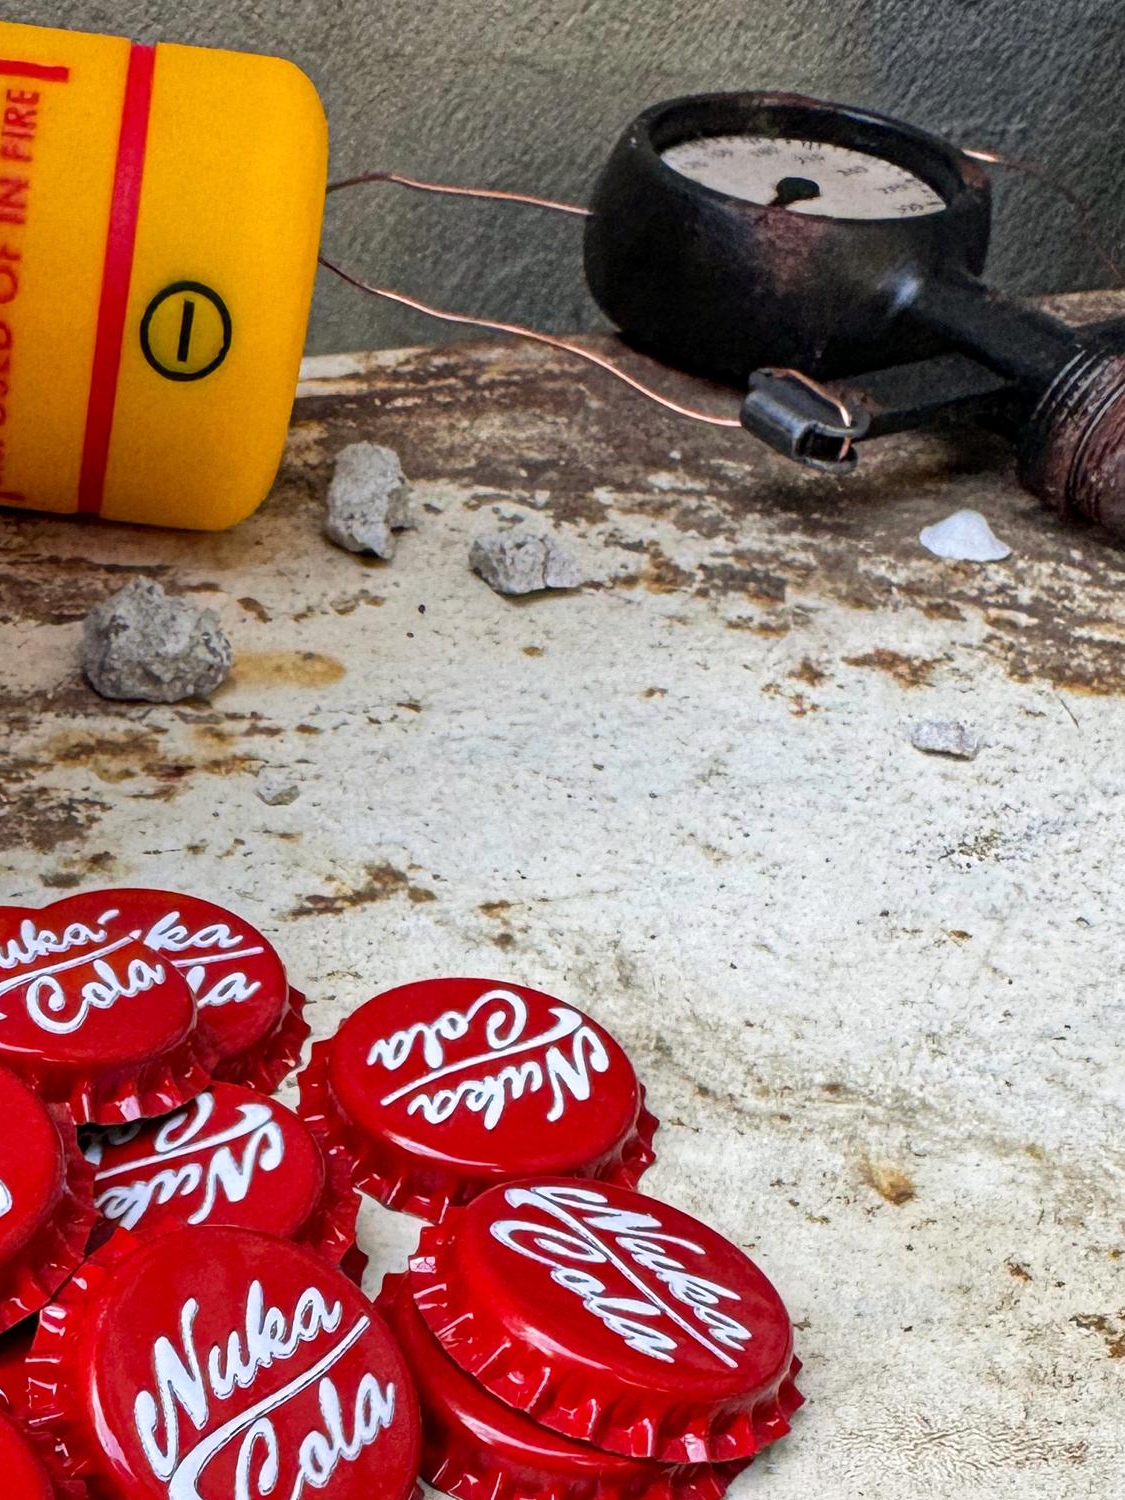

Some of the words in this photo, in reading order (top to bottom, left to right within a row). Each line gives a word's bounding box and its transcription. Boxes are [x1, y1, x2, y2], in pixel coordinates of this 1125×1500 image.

[0, 88, 40, 163] FIRE
[25, 958, 167, 1035] Cola
[366, 989, 528, 1071] Cola
[406, 1026, 610, 1131] Nuka
[93, 1119, 285, 1231] Nuk
[489, 1219, 678, 1364] Cola
[530, 1186, 753, 1352] Nuka
[134, 1279, 343, 1482] Nuka
